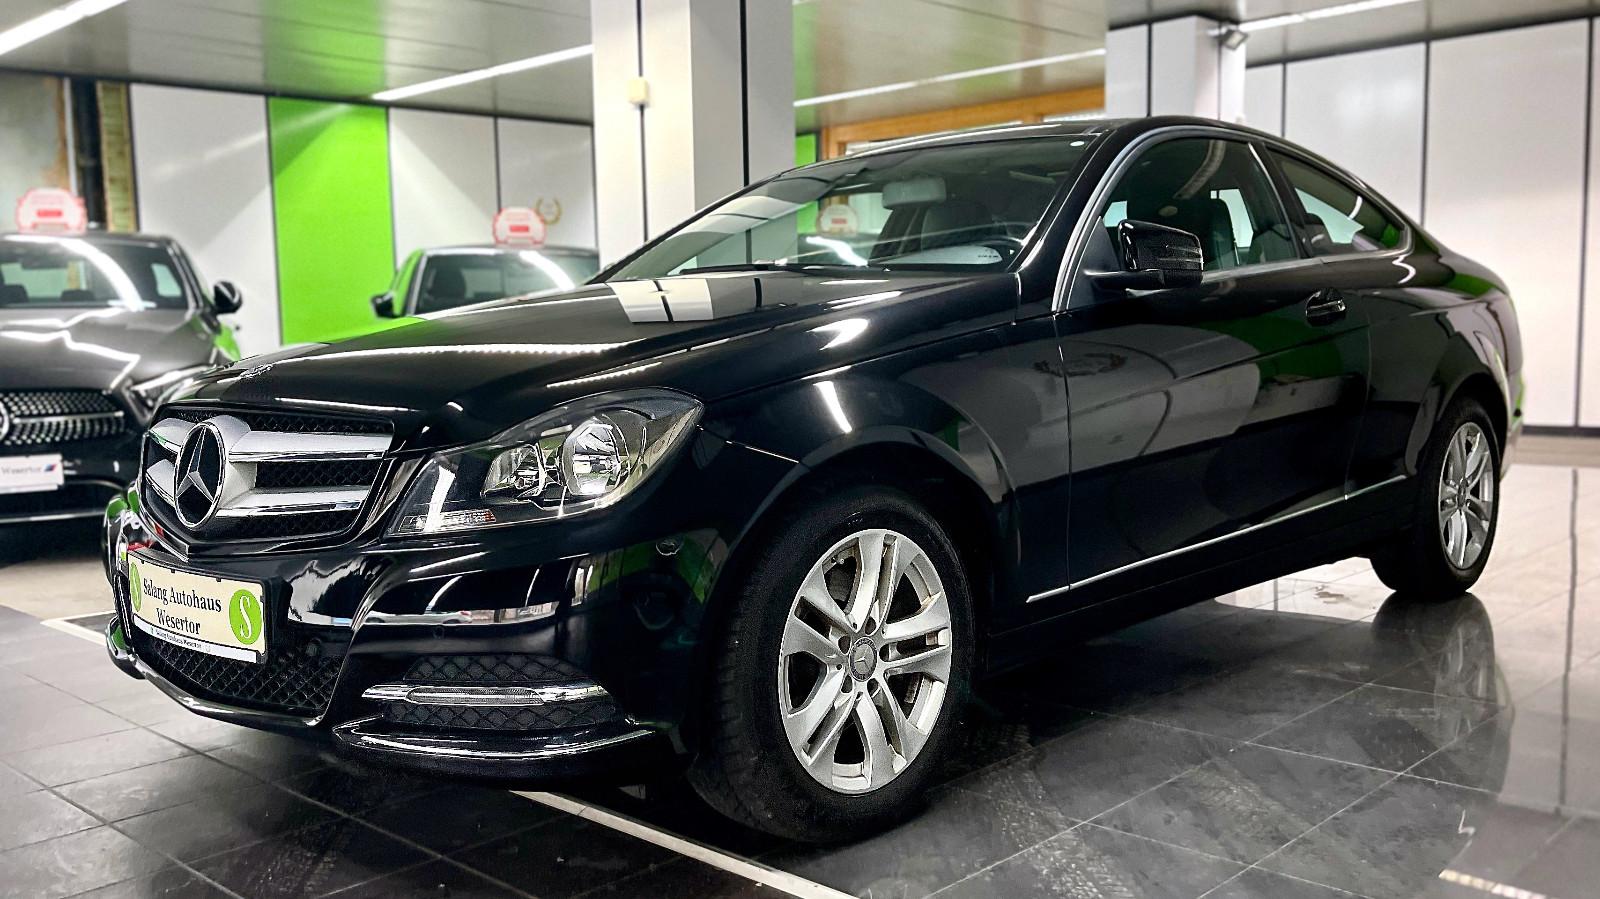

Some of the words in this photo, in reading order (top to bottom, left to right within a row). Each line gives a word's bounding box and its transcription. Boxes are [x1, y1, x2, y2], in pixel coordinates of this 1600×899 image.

[143, 577, 169, 606] Salang
[170, 586, 222, 613] Autohaus
[156, 607, 201, 635] Wesertor
[239, 595, 252, 639] S
